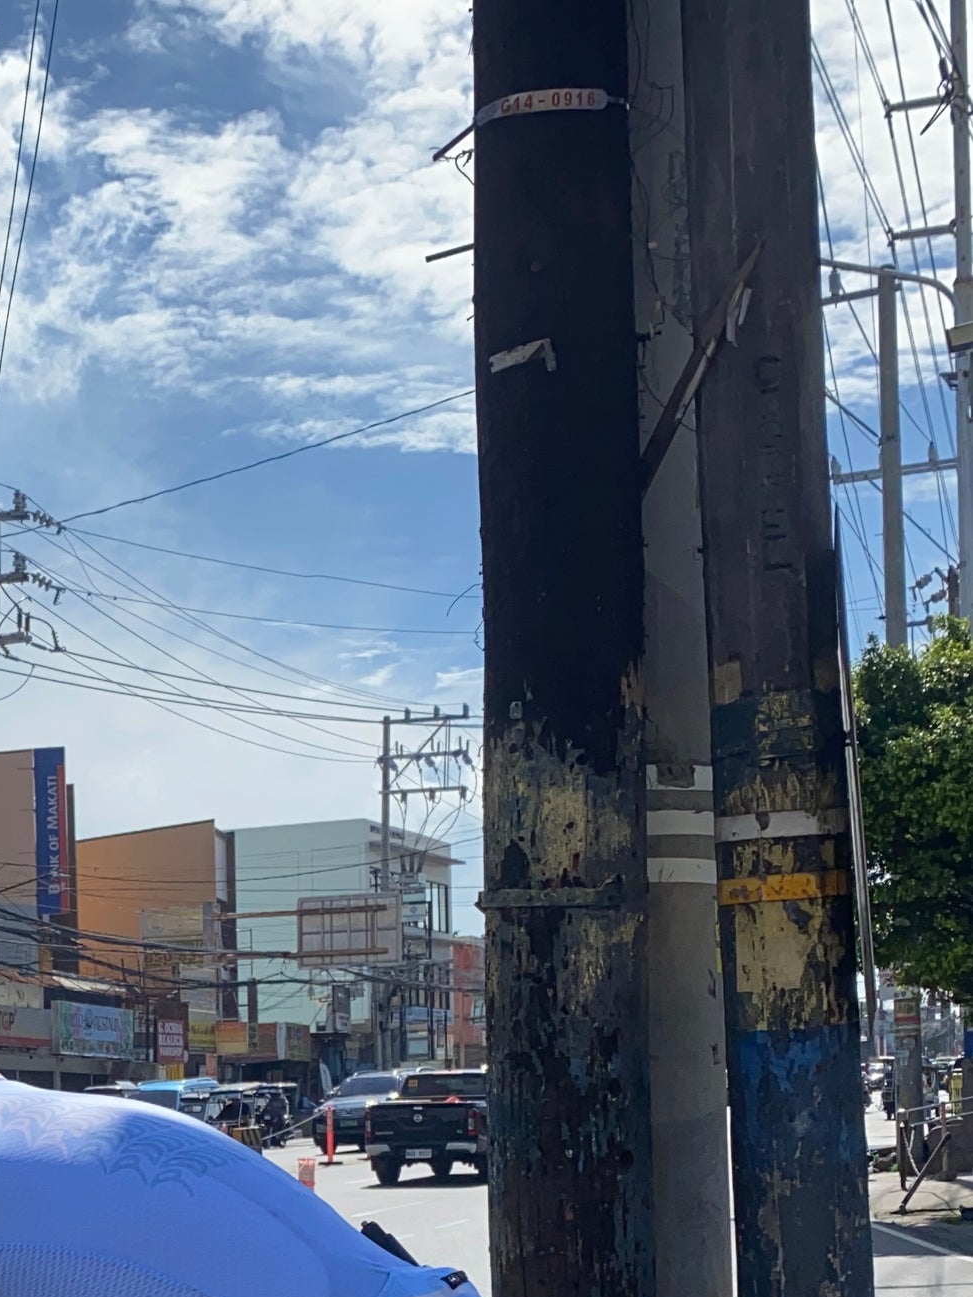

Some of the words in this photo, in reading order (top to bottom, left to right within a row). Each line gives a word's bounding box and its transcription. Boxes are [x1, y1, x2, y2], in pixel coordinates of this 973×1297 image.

[47, 775, 59, 829] MAKATI
[49, 836, 59, 850] OF
[48, 855, 60, 894] BNK
